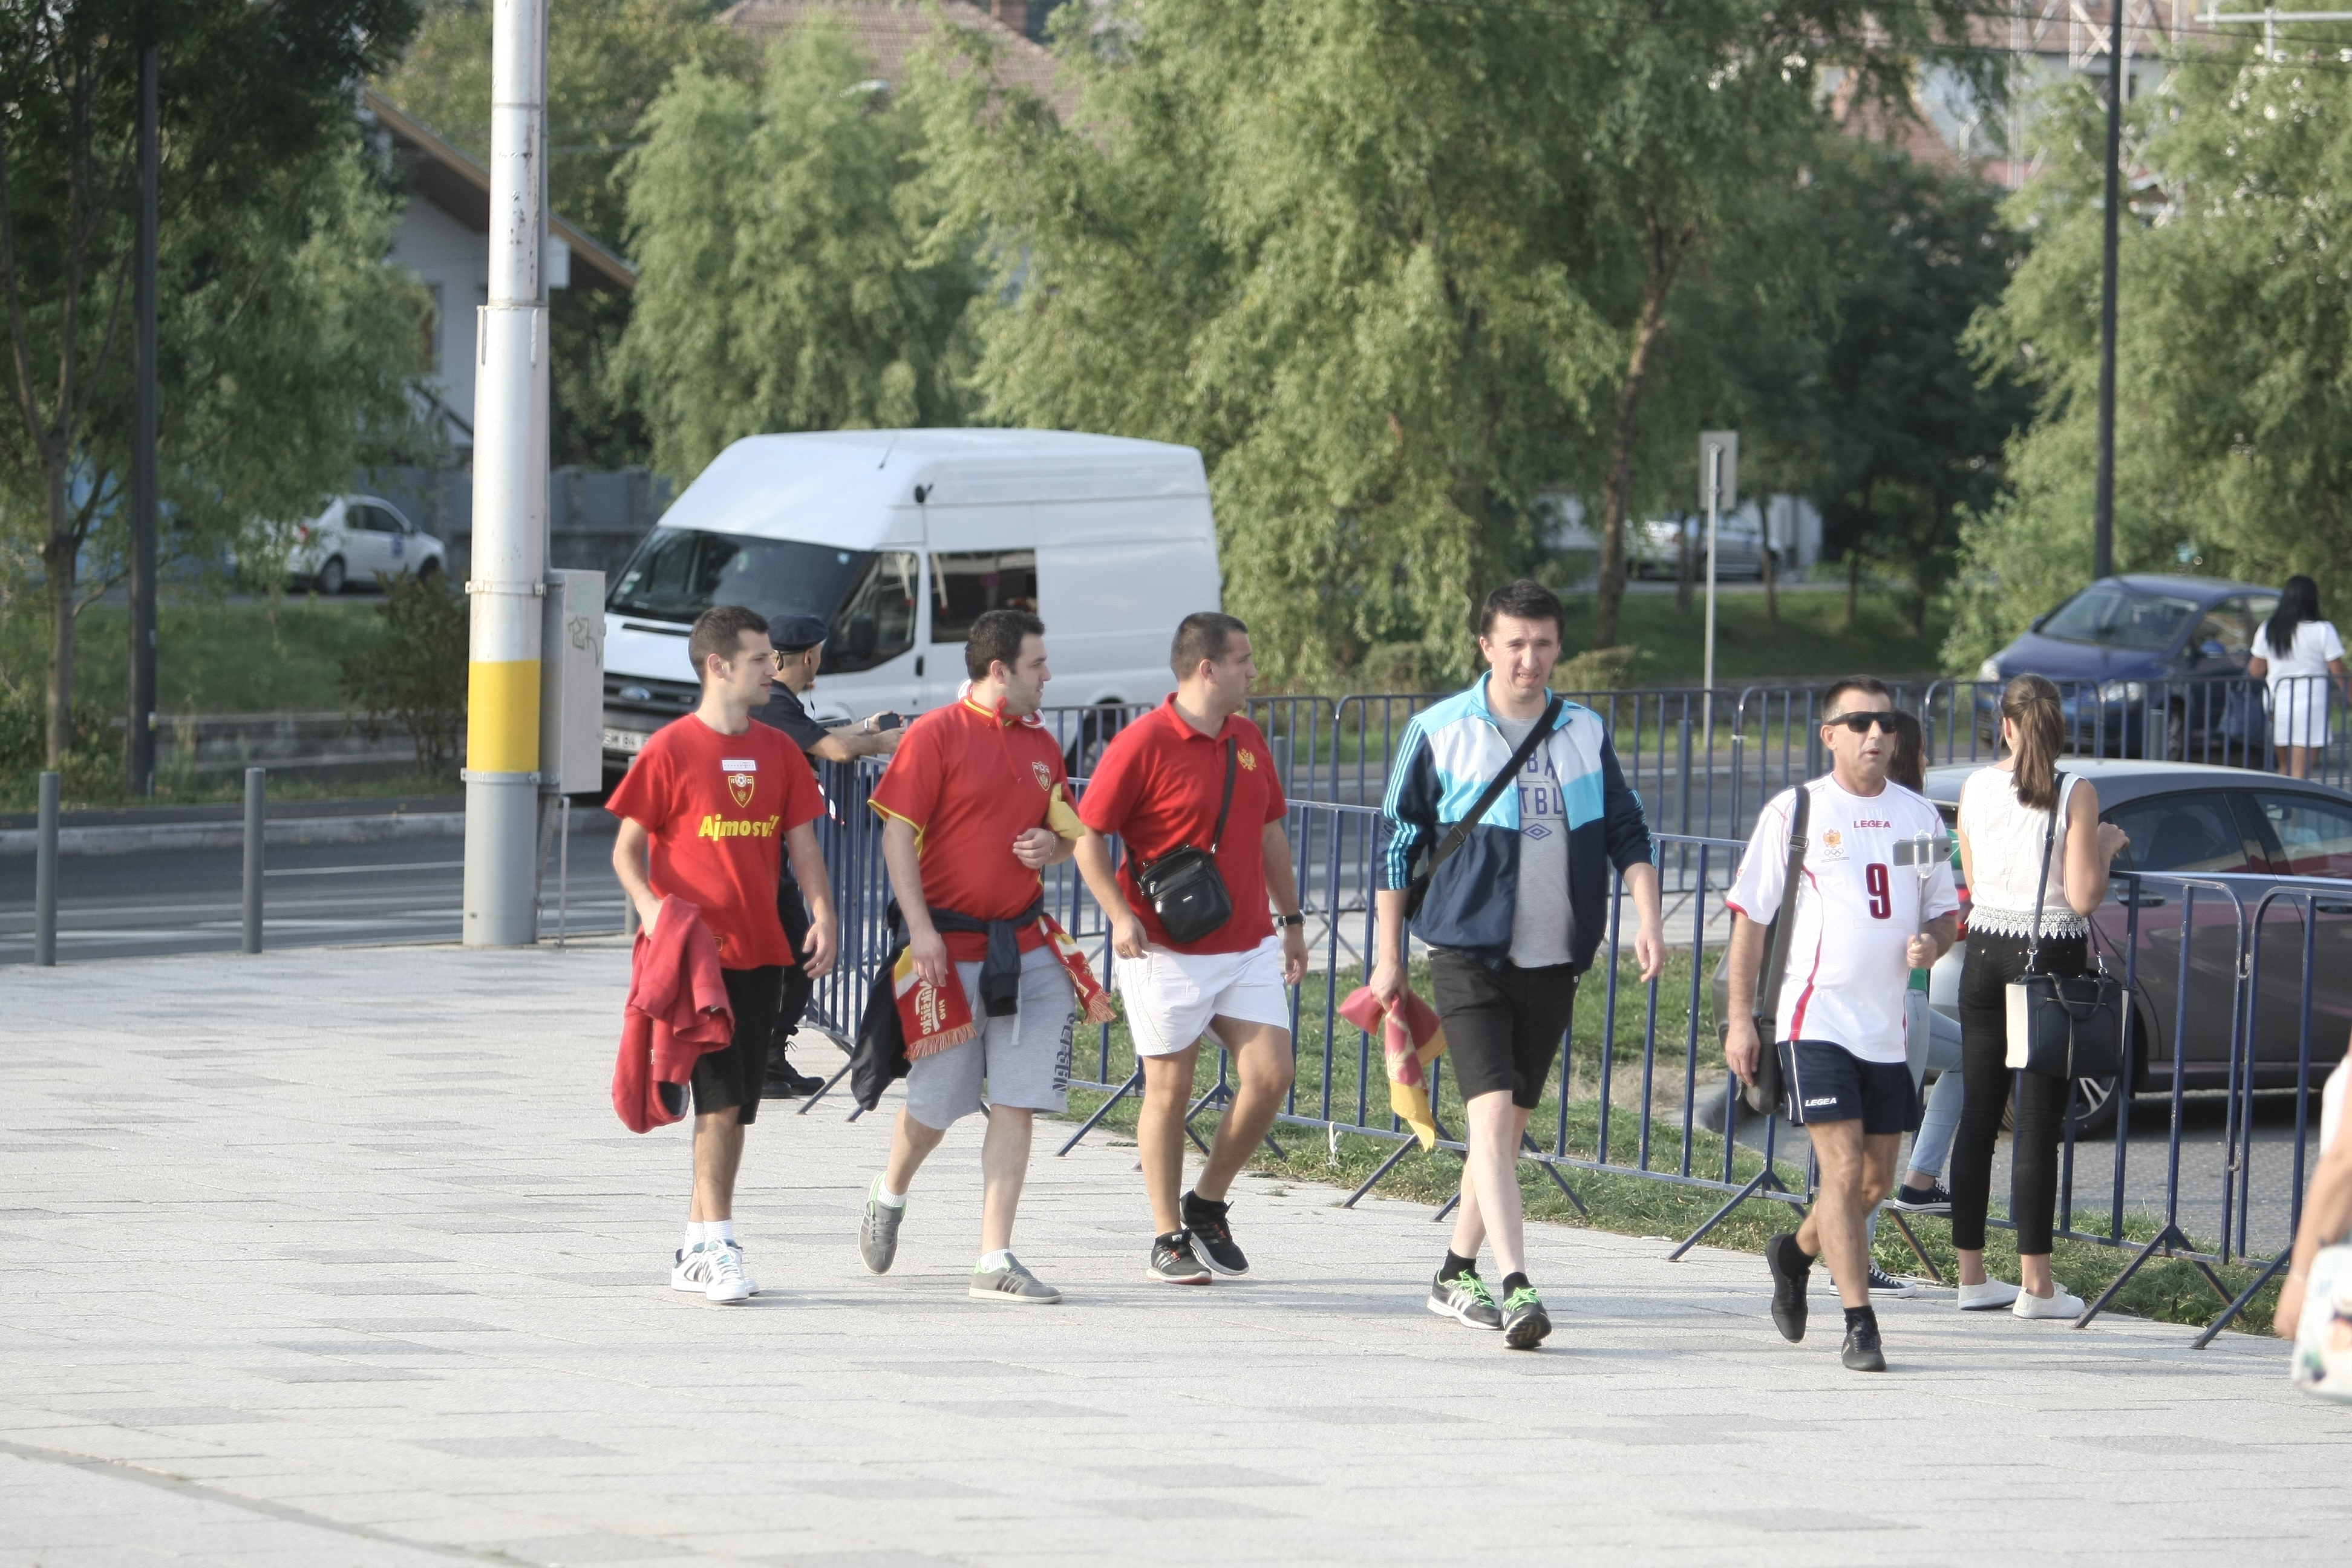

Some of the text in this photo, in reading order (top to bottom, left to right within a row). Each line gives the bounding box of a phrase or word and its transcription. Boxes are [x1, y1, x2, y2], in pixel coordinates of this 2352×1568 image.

[1854, 820, 1892, 828] LEGEA
[1866, 863, 1892, 919] 9
[1805, 1097, 1837, 1107] LEGEA
